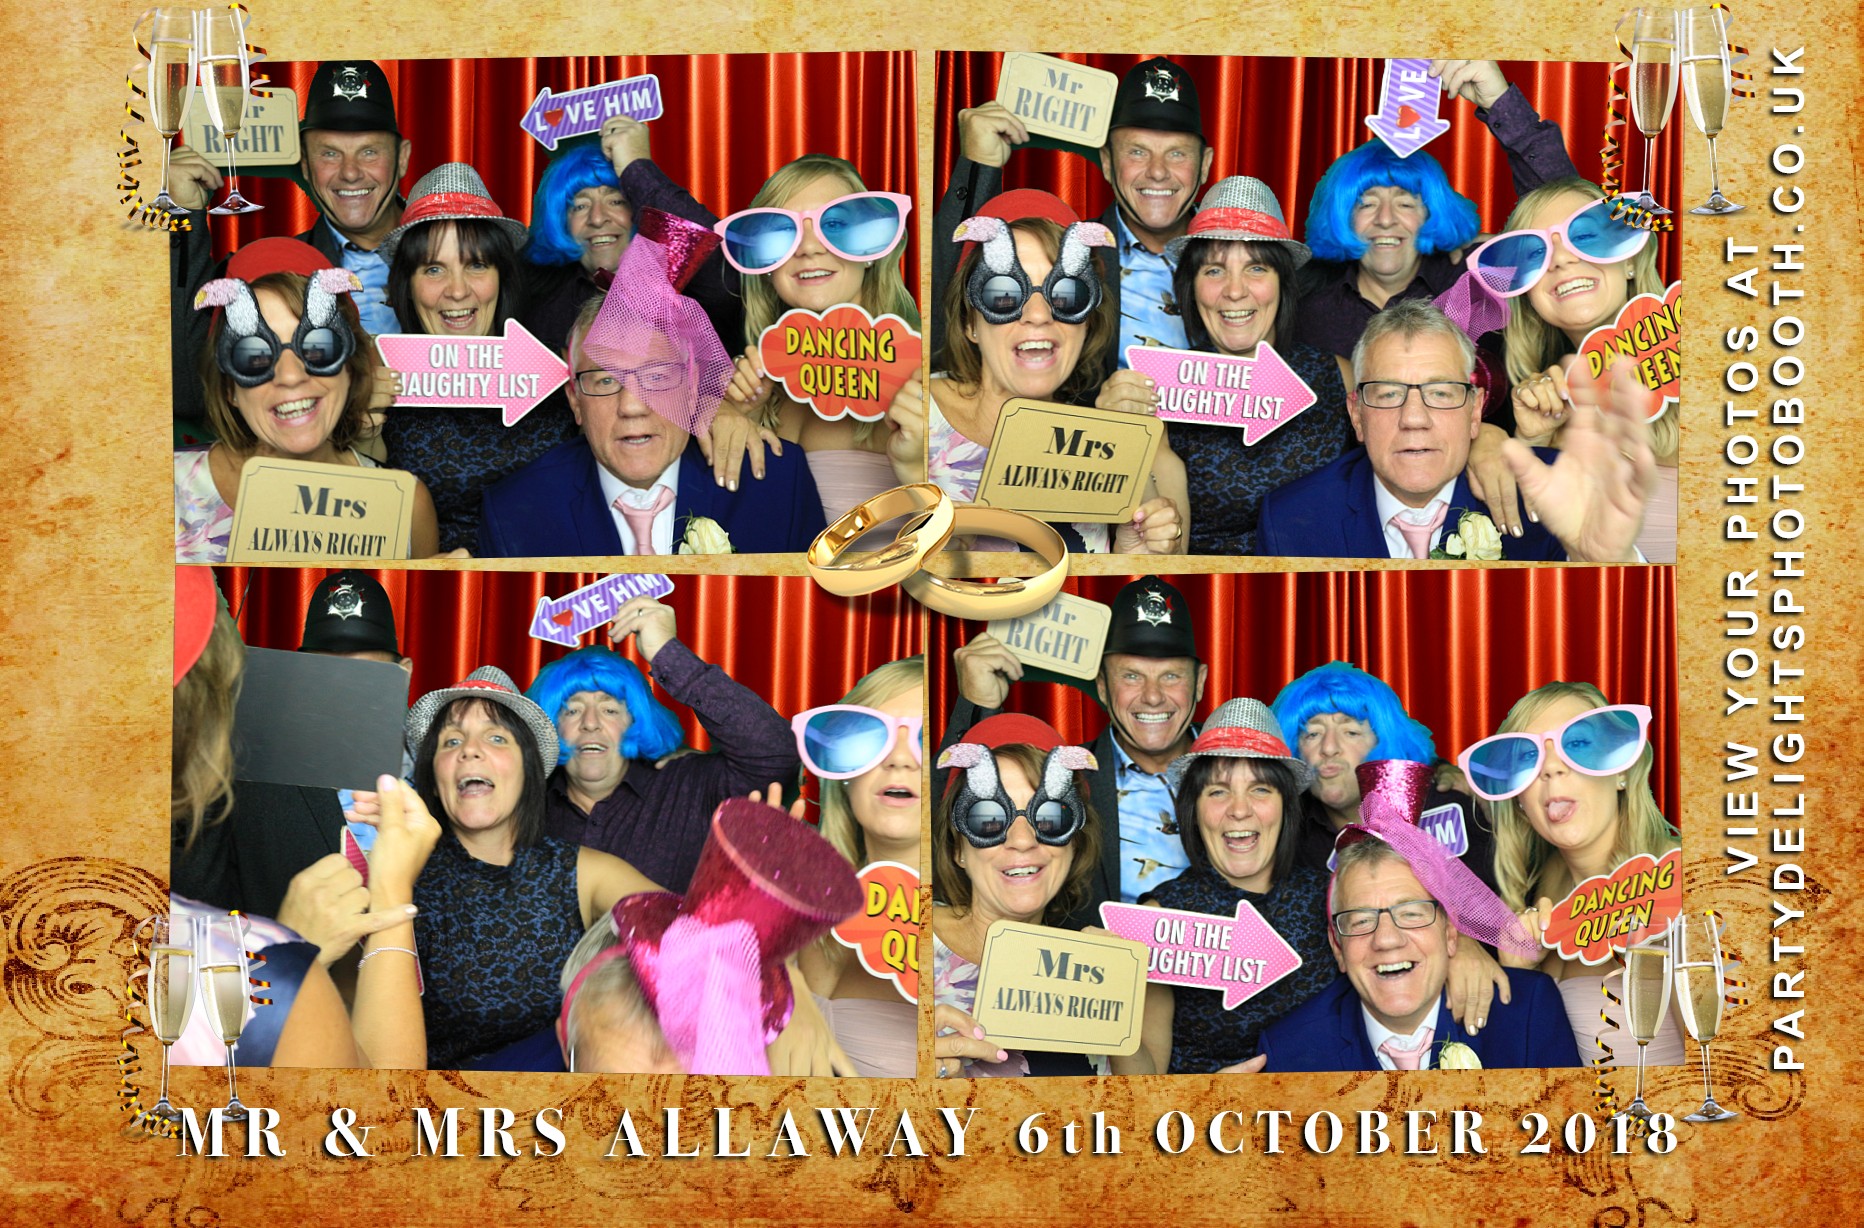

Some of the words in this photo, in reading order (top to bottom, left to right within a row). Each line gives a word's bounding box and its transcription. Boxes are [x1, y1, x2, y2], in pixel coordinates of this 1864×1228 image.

[1043, 67, 1083, 95] Mr
[604, 88, 652, 117] HIM
[1013, 86, 1096, 132] RIGHT
[429, 343, 459, 368] ON
[465, 344, 505, 369] THE
[785, 326, 896, 362] DANCING
[498, 373, 540, 399] LIST
[800, 363, 879, 401] QUEEN
[1178, 359, 1209, 385] ON
[1215, 363, 1253, 390] THE
[1155, 386, 1238, 417] AUGHTY
[1241, 394, 1285, 420] LIST
[1042, 425, 1117, 460] Mrs
[998, 464, 1072, 490] ALWAYS
[1071, 470, 1129, 493] RIGHT
[290, 484, 368, 519] Mrs
[246, 527, 323, 554] ALWAYS
[326, 532, 387, 557] RIGHT
[609, 574, 661, 603] HIM
[1005, 617, 1089, 664] RIGHT
[1569, 860, 1675, 920] DANCING
[1154, 917, 1187, 945] ON
[1193, 921, 1234, 951] THE
[1574, 899, 1655, 948] QUEEN
[1032, 948, 1105, 985] Mrs
[1147, 946, 1216, 978] UGHTY
[1221, 955, 1267, 984] LIST
[992, 987, 1064, 1016] ALWAYS
[1066, 995, 1124, 1022] RIGHT
